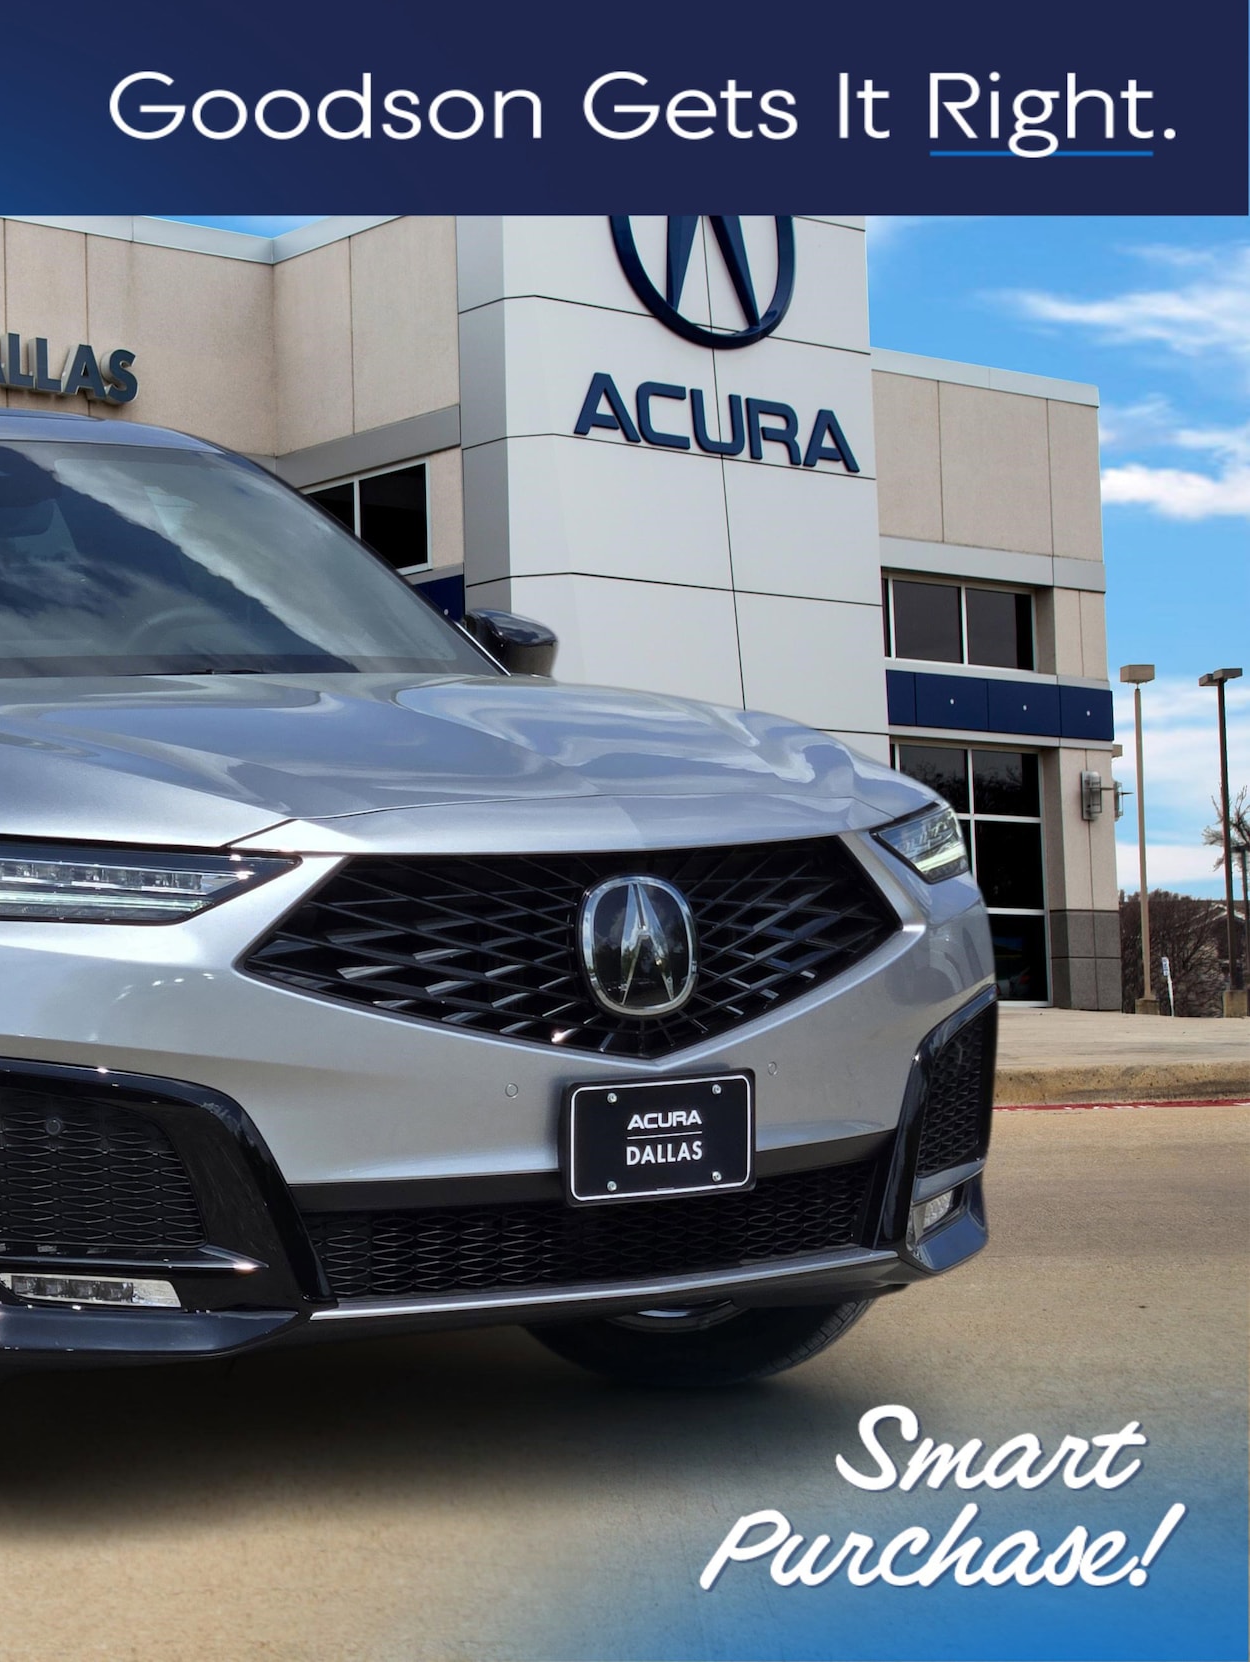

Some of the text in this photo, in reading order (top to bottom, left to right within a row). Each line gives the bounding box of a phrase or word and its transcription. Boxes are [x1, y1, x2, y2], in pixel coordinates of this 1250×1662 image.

[573, 372, 860, 473] ACURA
[627, 1109, 703, 1131] ACURA
[626, 1140, 703, 1166] DALLAS
